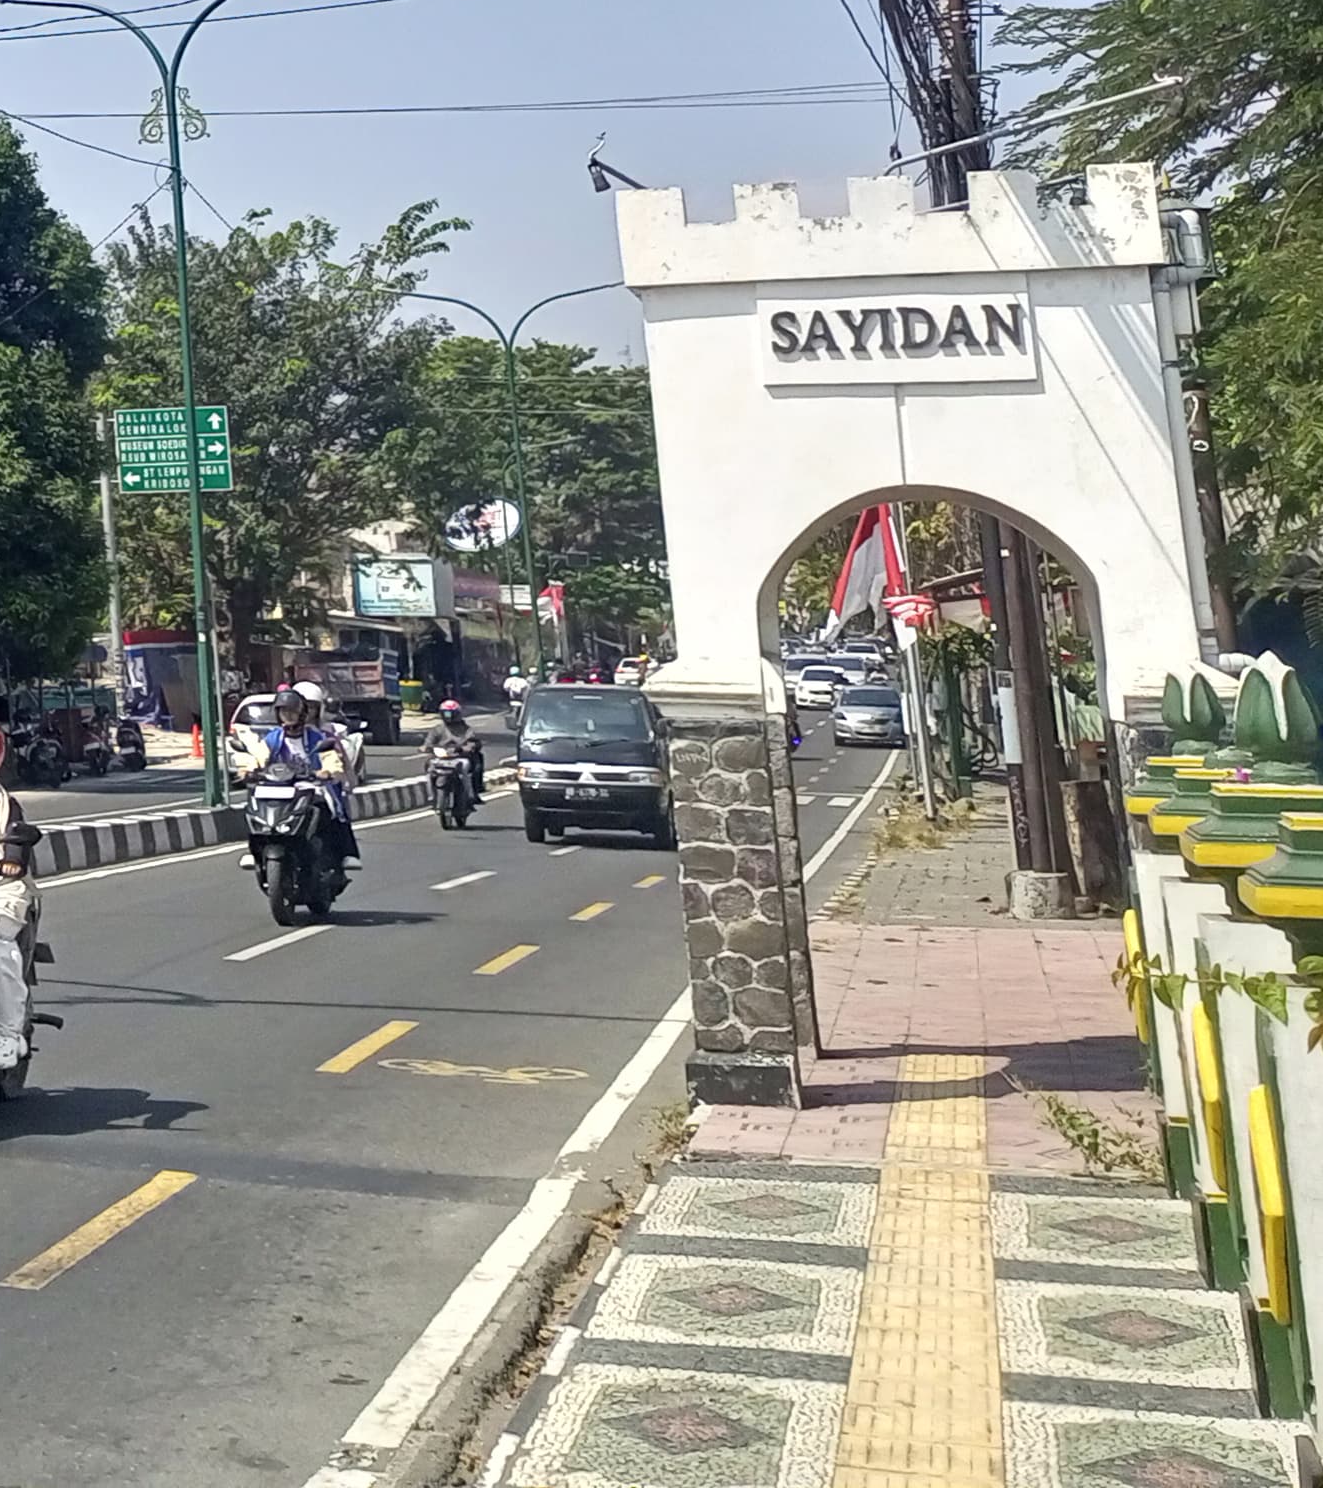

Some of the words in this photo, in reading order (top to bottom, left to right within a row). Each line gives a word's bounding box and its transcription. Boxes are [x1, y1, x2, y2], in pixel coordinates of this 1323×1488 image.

[770, 304, 1023, 353] SAYIDAN
[118, 413, 153, 424] BALAI
[155, 411, 184, 422] KOTA
[119, 423, 188, 436] GEMBIRALOK
[120, 440, 155, 451] MUSEUM
[121, 452, 146, 463] RSUD
[143, 467, 156, 478] ST
[158, 465, 225, 478] LEMPUNGAN
